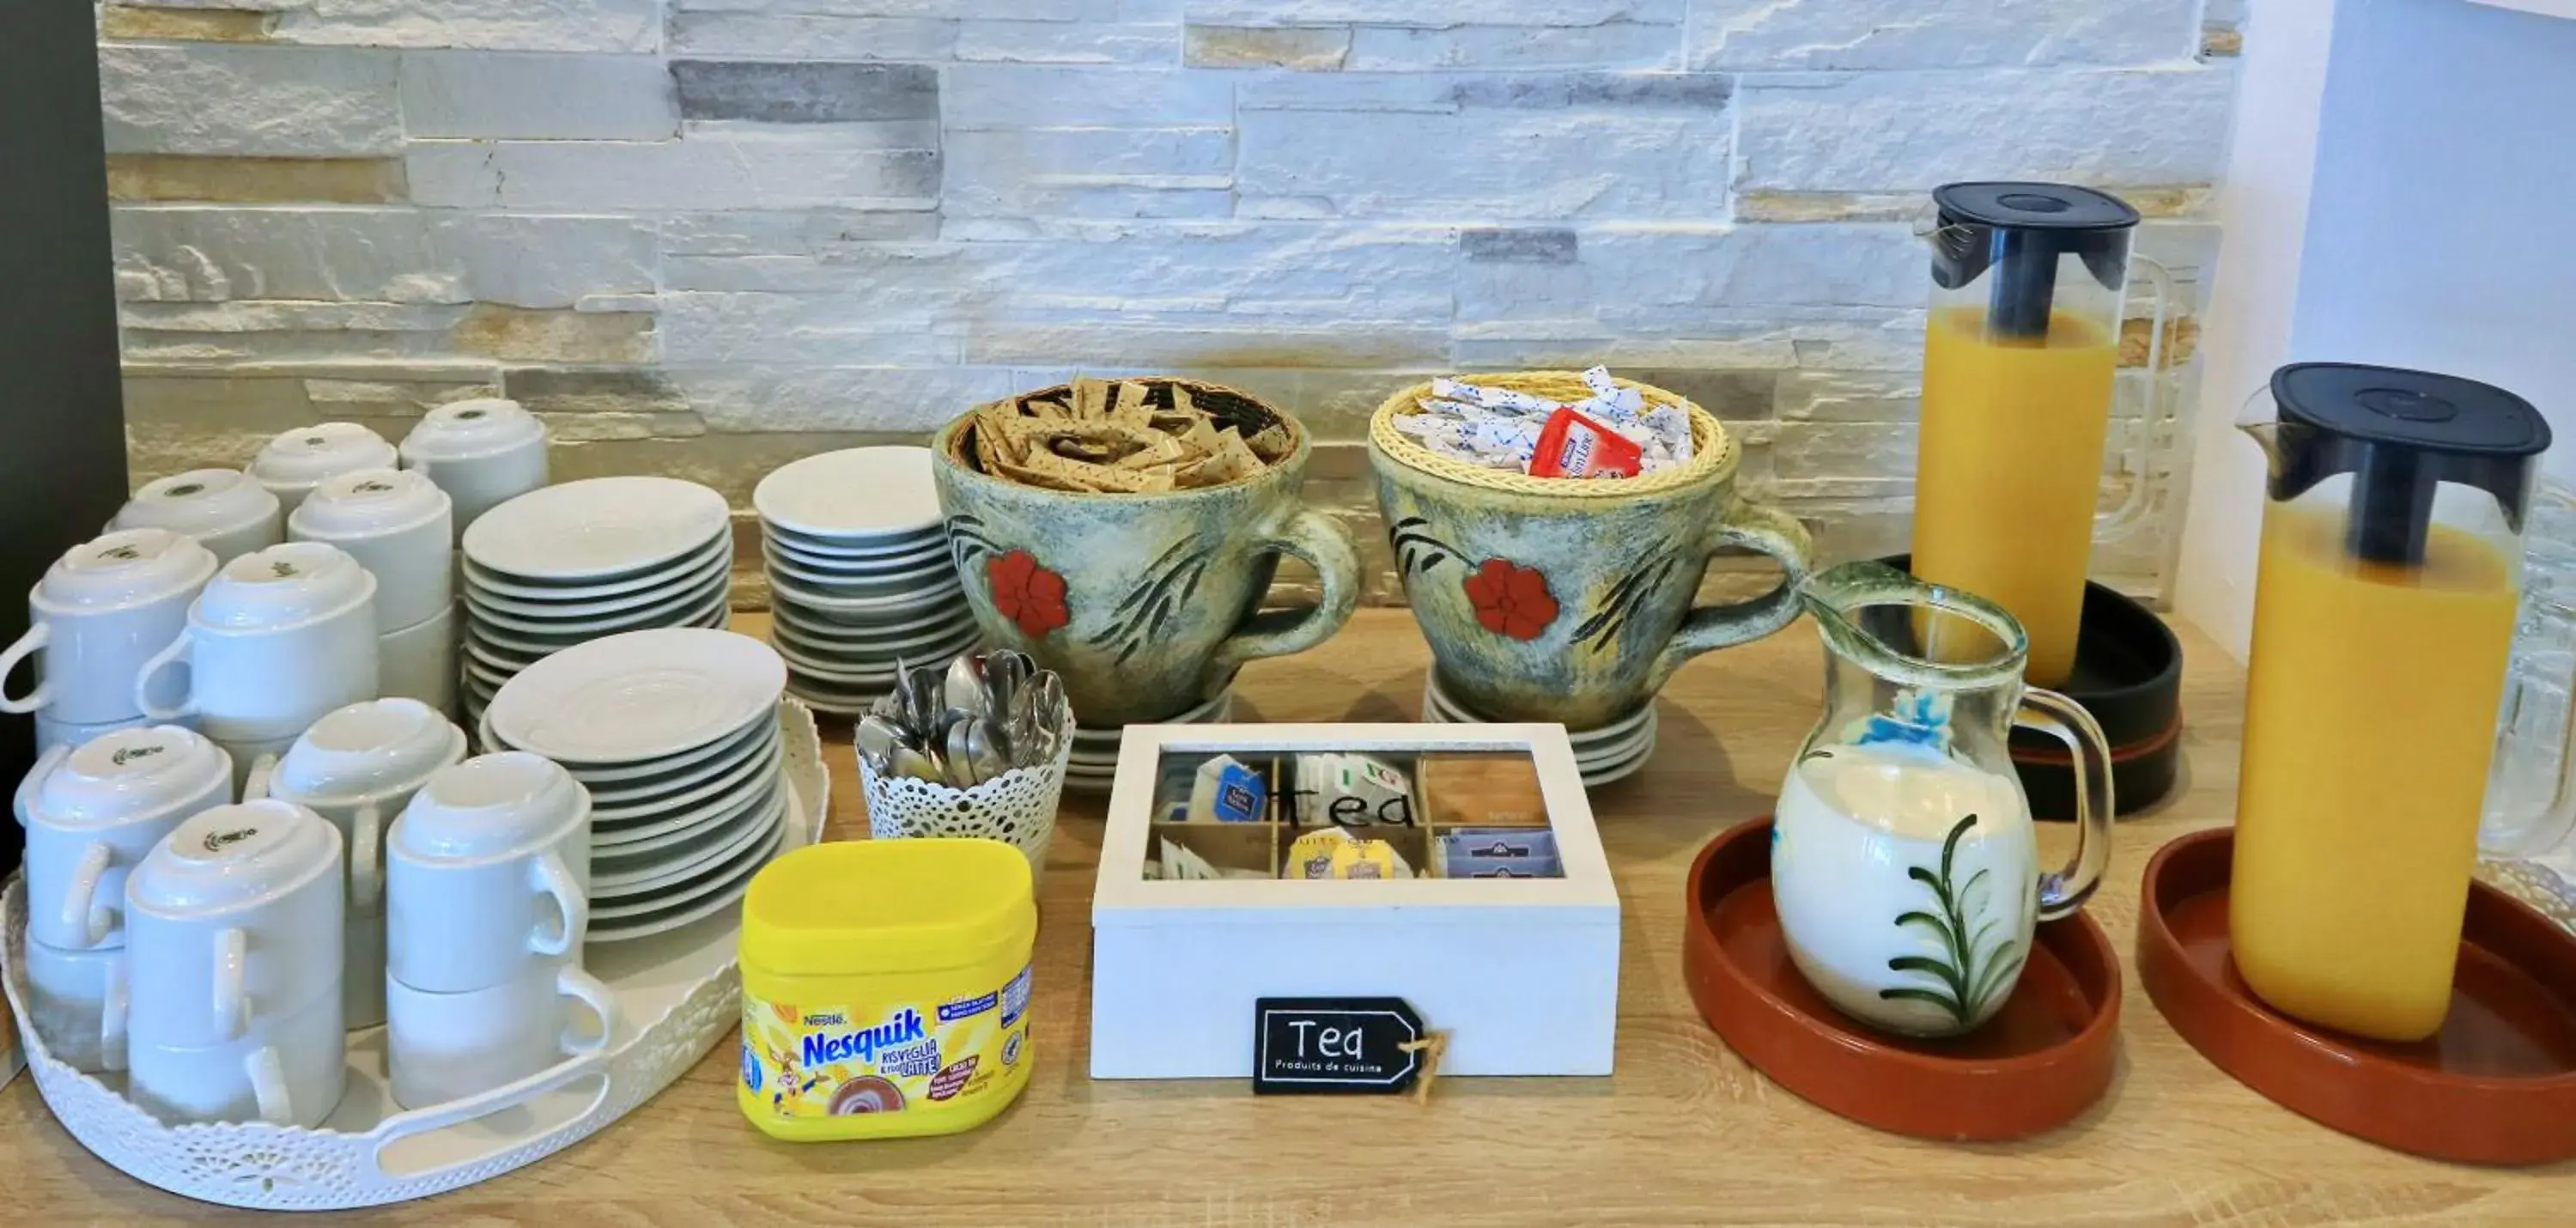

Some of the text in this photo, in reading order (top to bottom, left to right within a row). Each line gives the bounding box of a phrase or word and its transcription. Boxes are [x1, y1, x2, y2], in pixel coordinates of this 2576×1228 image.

[1266, 791, 1415, 830] Tea
[803, 1008, 924, 1067] Nesquik
[882, 1038, 937, 1064] RISVEGLIA
[1289, 1020, 1363, 1060] Tea
[1275, 1059, 1382, 1073] Produits de cuisine
